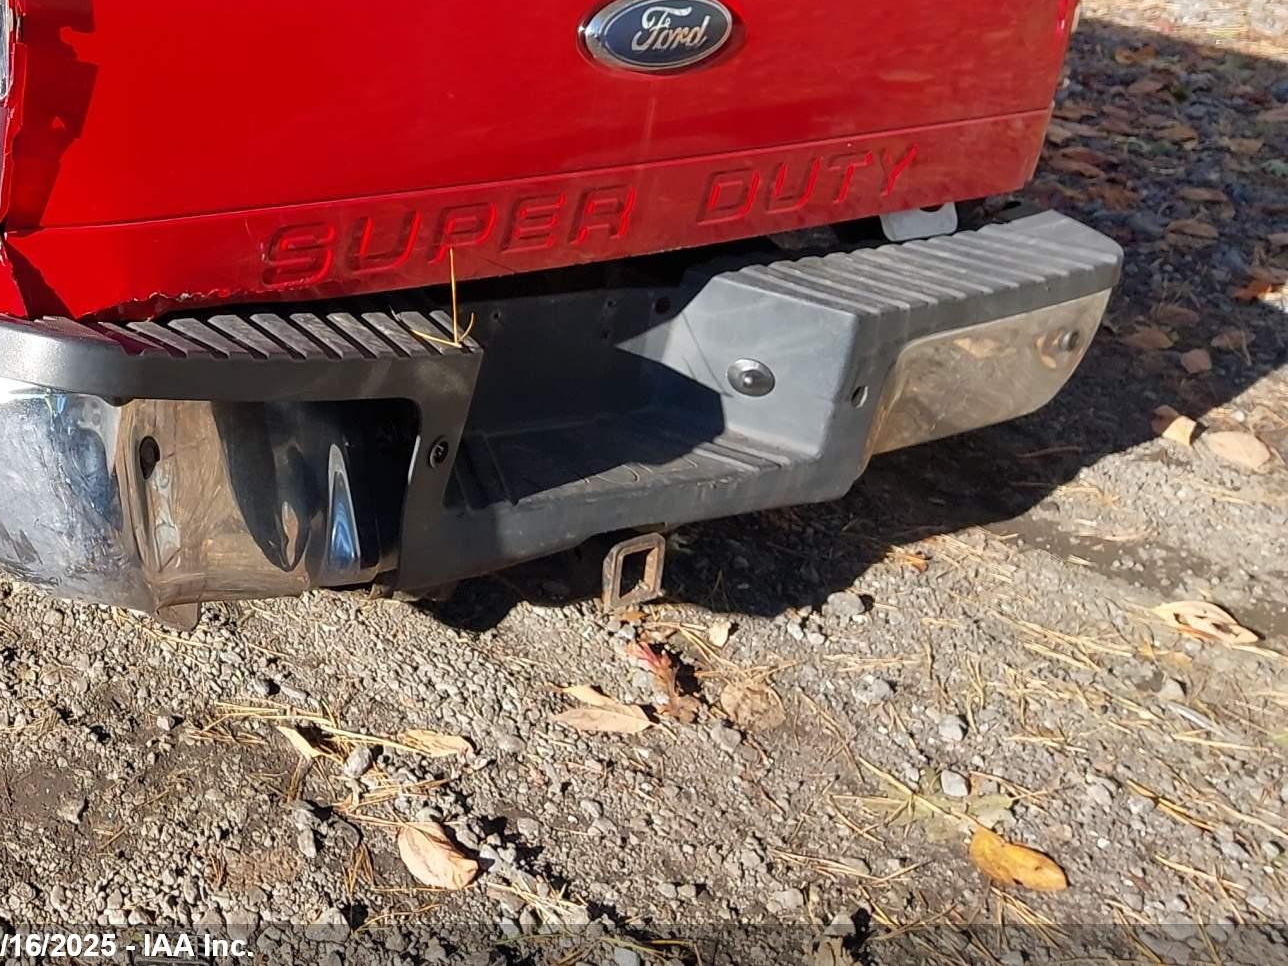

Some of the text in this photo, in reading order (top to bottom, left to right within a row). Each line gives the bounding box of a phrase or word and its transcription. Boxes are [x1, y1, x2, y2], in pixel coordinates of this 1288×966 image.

[631, 6, 711, 51] Ford
[260, 144, 918, 288] SUPER DUTY
